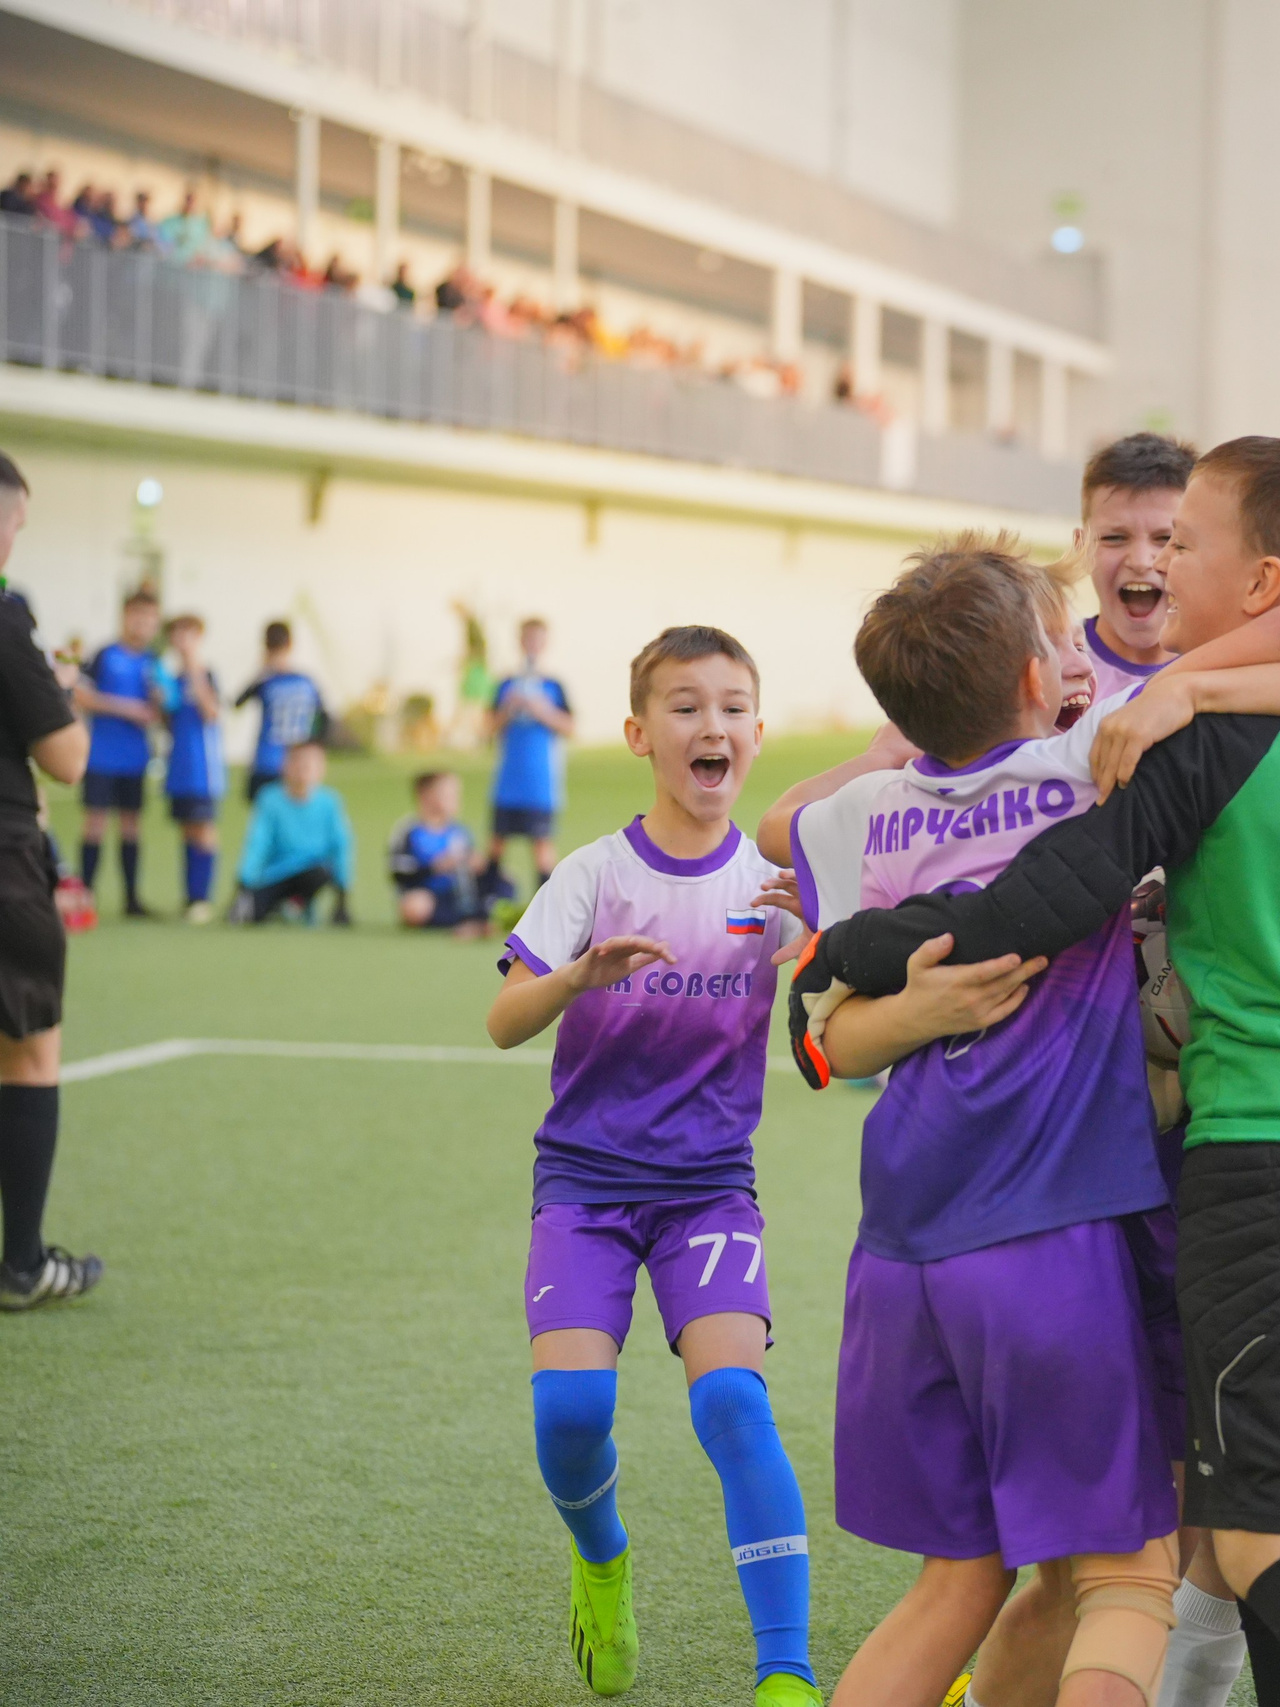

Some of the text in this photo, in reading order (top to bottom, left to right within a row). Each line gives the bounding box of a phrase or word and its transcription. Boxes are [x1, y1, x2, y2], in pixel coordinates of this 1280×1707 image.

[863, 778, 1076, 856] МАРЧЕНКО
[688, 1231, 761, 1288] 77
[736, 1542, 797, 1562] JÖGEL
